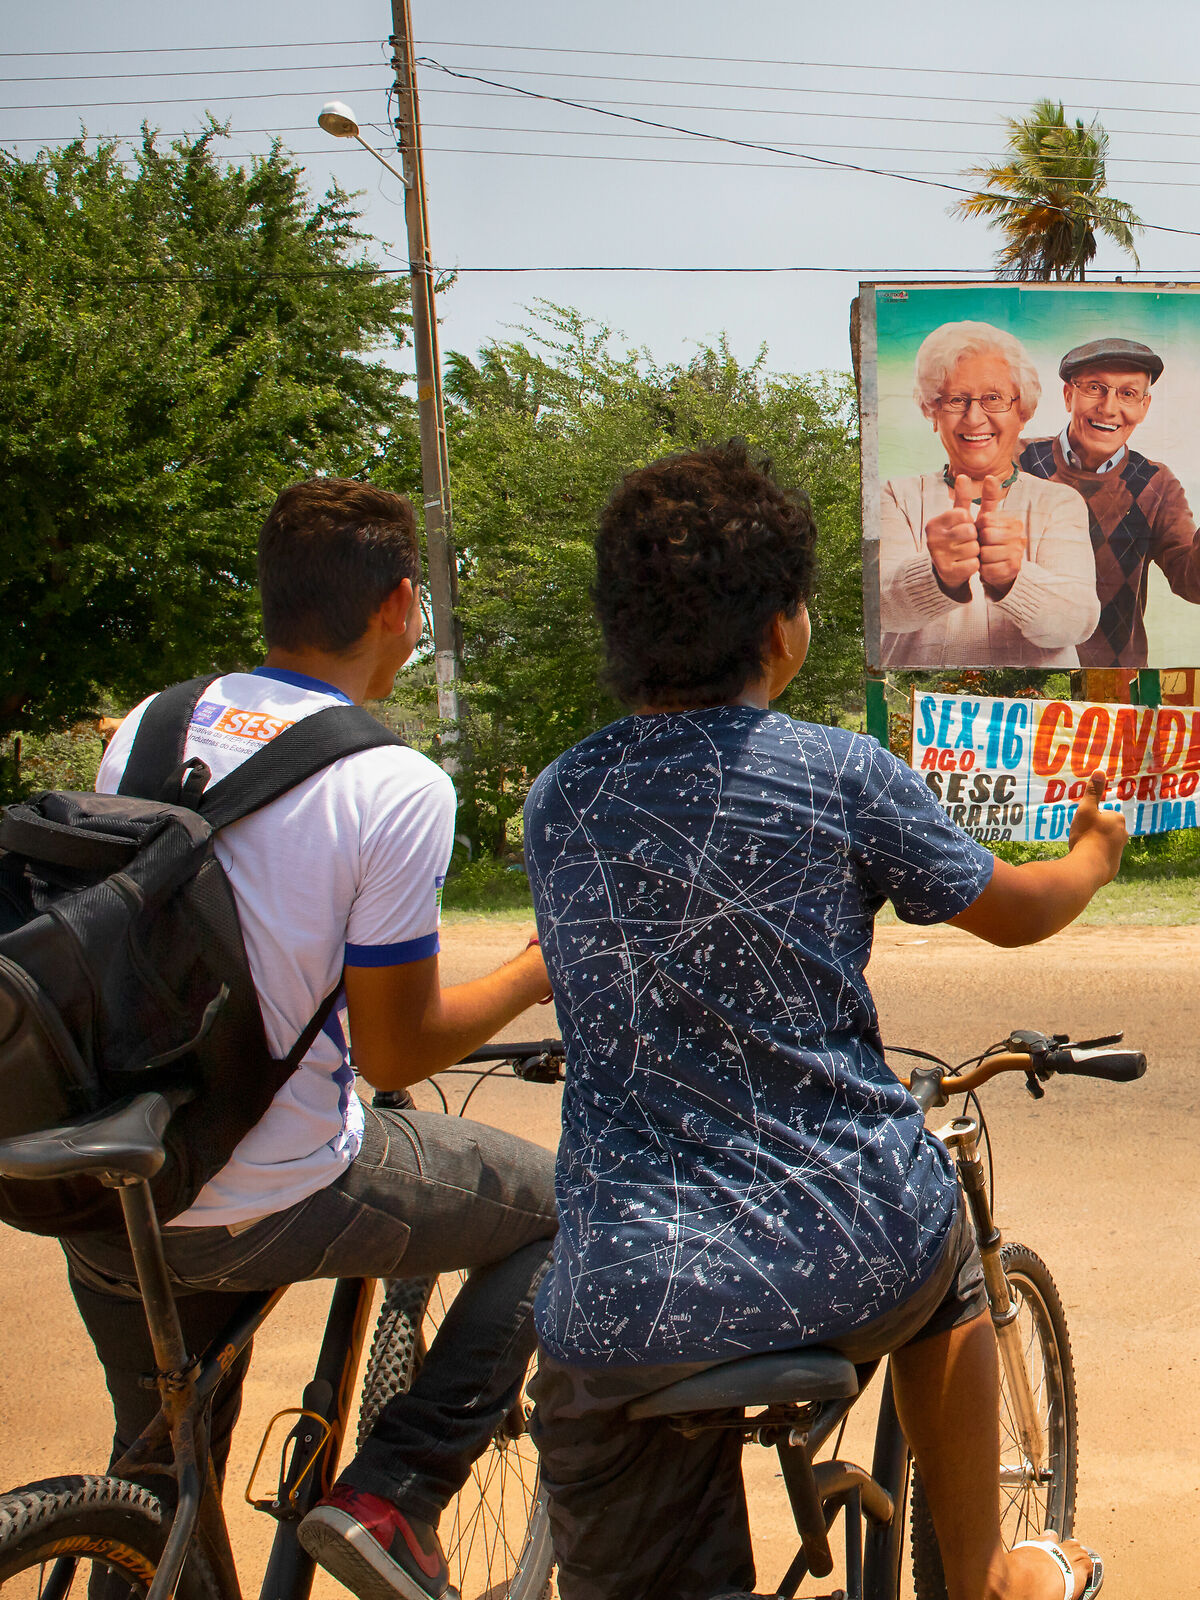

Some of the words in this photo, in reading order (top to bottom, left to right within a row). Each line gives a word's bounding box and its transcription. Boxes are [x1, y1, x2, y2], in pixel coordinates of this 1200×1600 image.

[224, 713, 293, 740] SES
[917, 696, 984, 750] SEX.
[986, 702, 1028, 770] 16
[920, 747, 980, 773] AGO.
[925, 771, 1017, 804] SESC
[1044, 779, 1087, 803] DO
[941, 803, 982, 828] IRA
[986, 803, 1024, 826] RIO
[216, 1343, 237, 1371] 29
